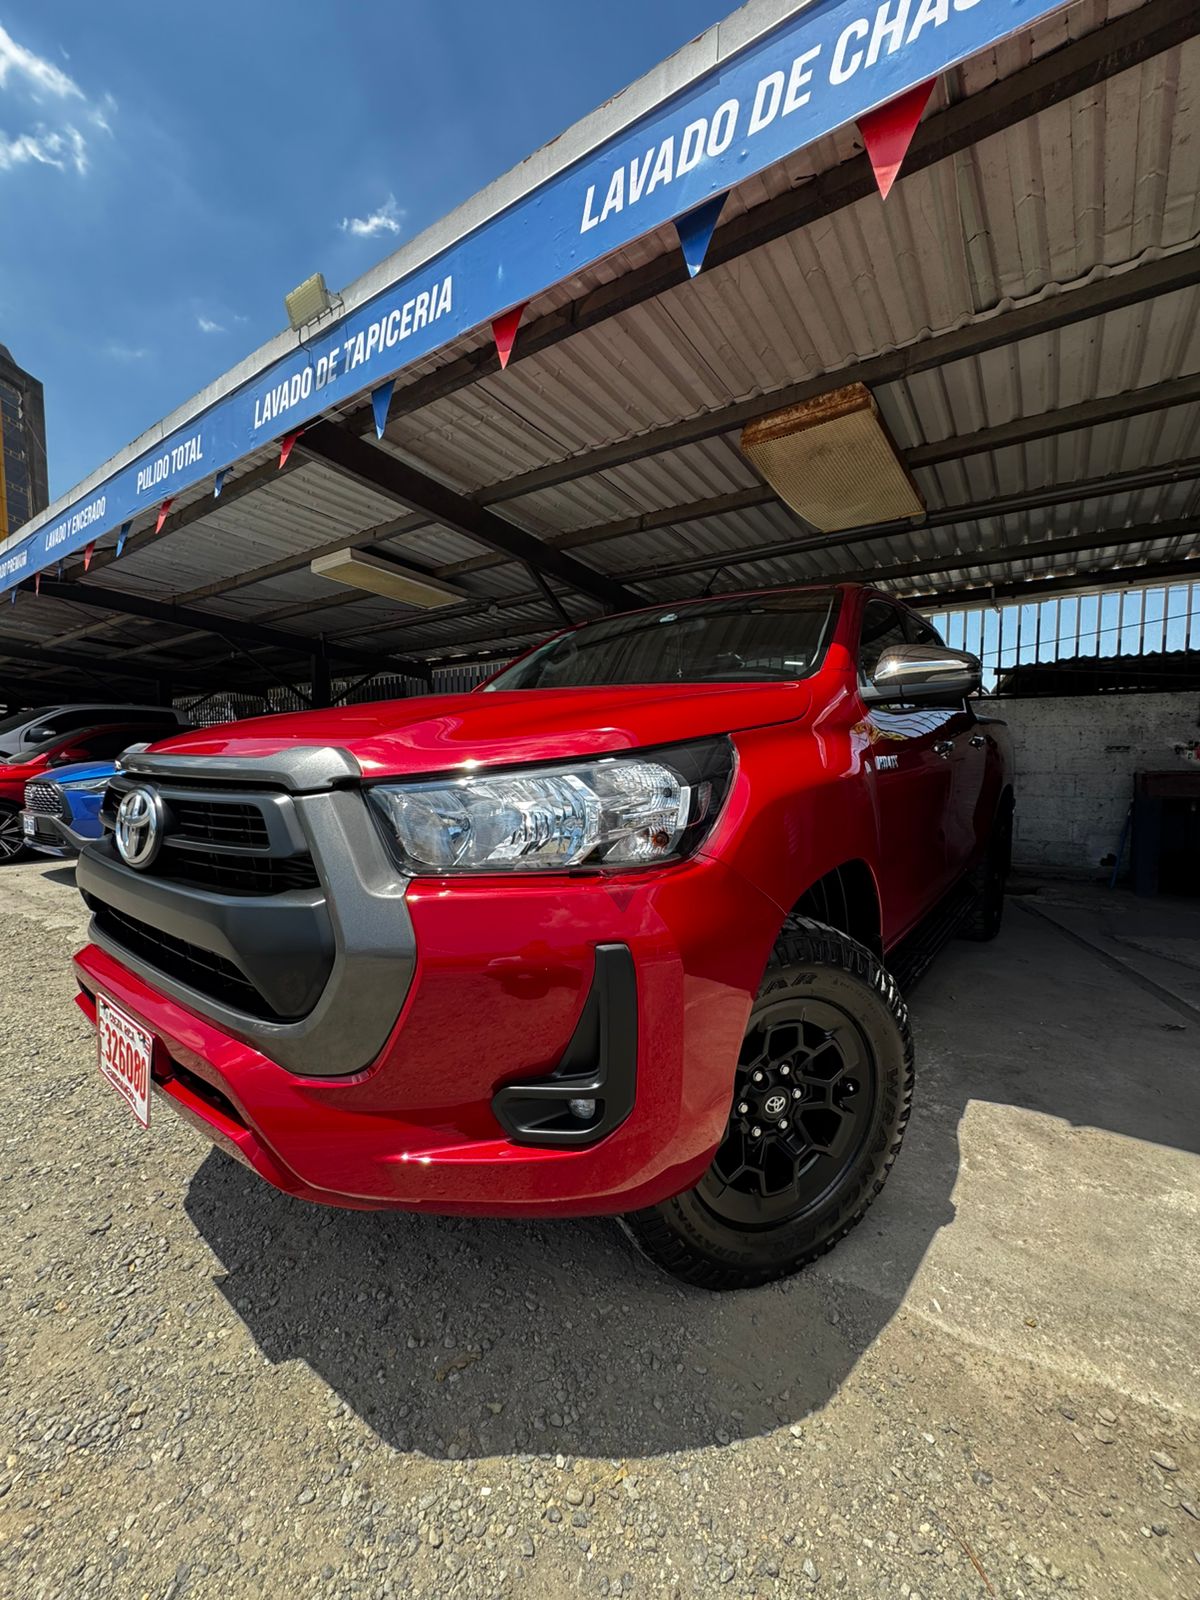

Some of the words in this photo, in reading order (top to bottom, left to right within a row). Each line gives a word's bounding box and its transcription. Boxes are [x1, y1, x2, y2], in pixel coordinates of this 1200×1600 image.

[580, 99, 740, 234] LAVADO
[748, 44, 822, 136] DE
[829, 0, 981, 86] CHA
[254, 367, 313, 429] LAVADO
[315, 346, 340, 392] DE
[344, 275, 453, 375] TAPICERIA
[136, 454, 170, 495] PULIDO
[171, 434, 203, 474] TOTAL
[45, 521, 67, 552] LAVADO
[67, 517, 73, 538] Y
[72, 496, 106, 534] ENCERADO
